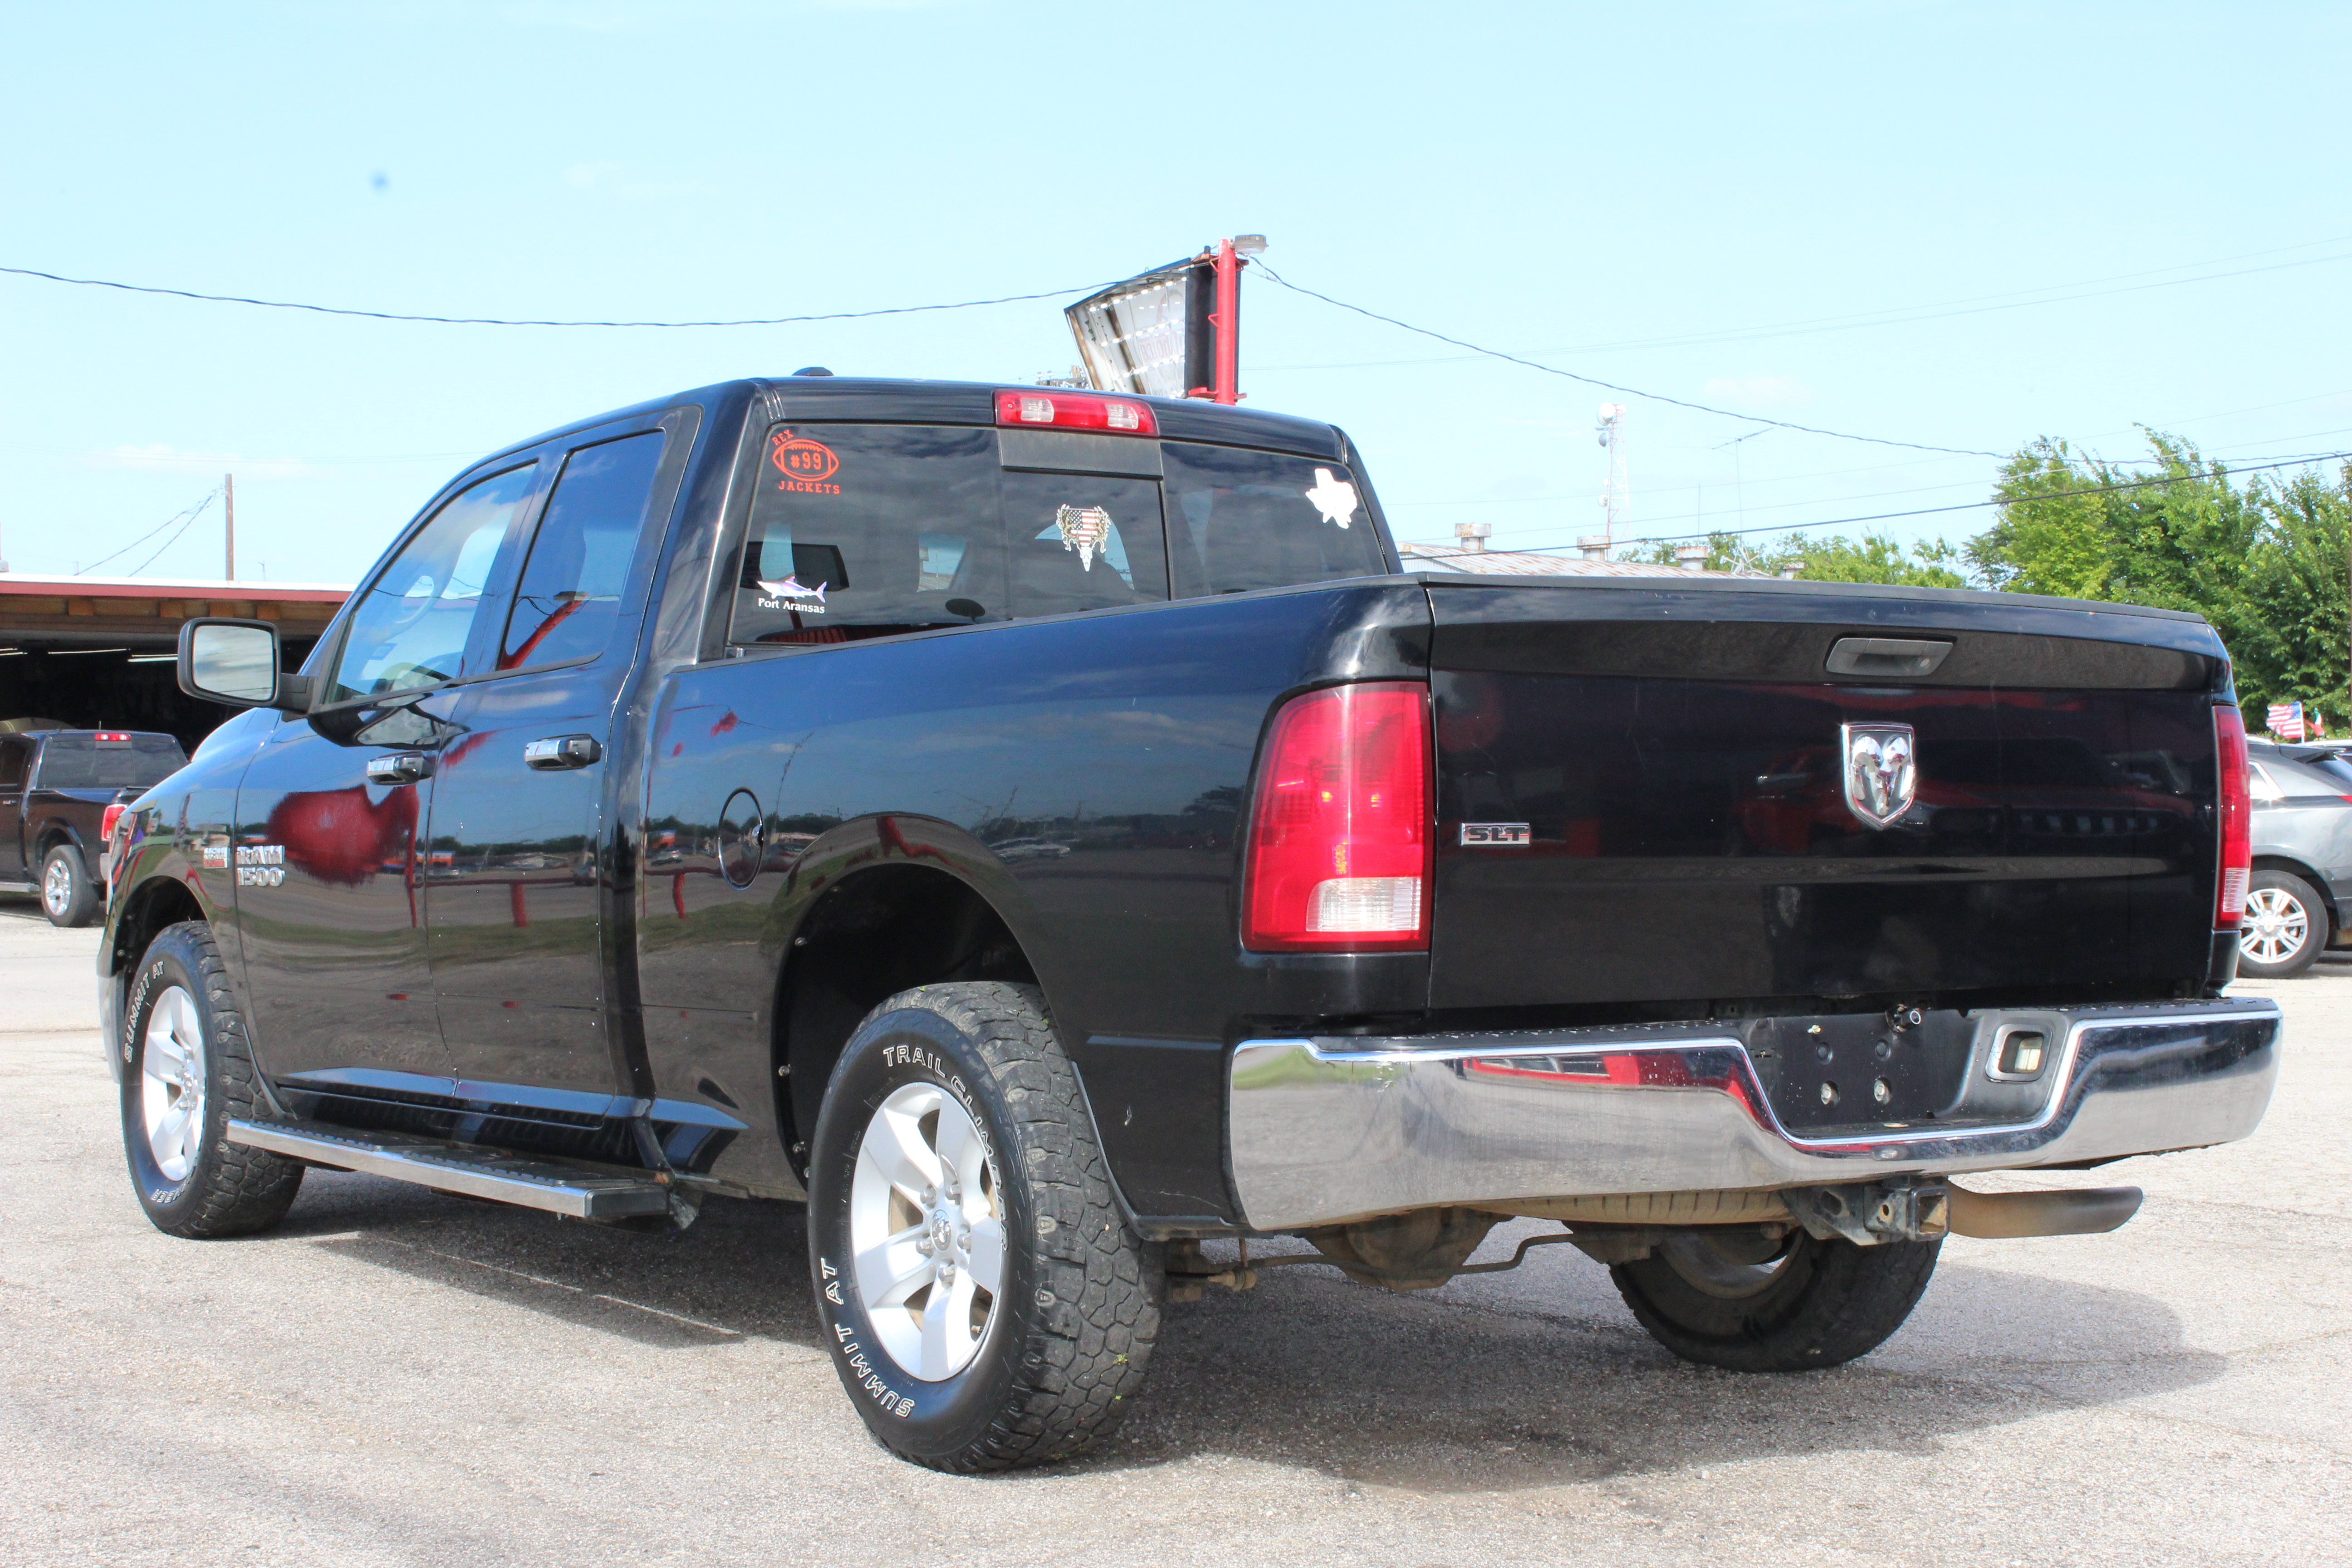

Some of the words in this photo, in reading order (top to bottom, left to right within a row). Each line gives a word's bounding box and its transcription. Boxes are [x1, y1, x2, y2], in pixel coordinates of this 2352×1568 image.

[772, 429, 794, 446] REX
[790, 451, 822, 470] #99
[778, 480, 841, 495] JACKETS
[758, 598, 780, 609] Port
[783, 601, 825, 614] Aransas
[1468, 827, 1528, 841] SLT
[237, 845, 285, 865] RAM
[237, 867, 286, 887] 1500
[124, 972, 150, 1063] SUMMIT
[152, 961, 164, 979] AT
[883, 1044, 946, 1079] TRAIL
[820, 1257, 844, 1305] AT
[834, 1323, 915, 1418] SUMMIT
